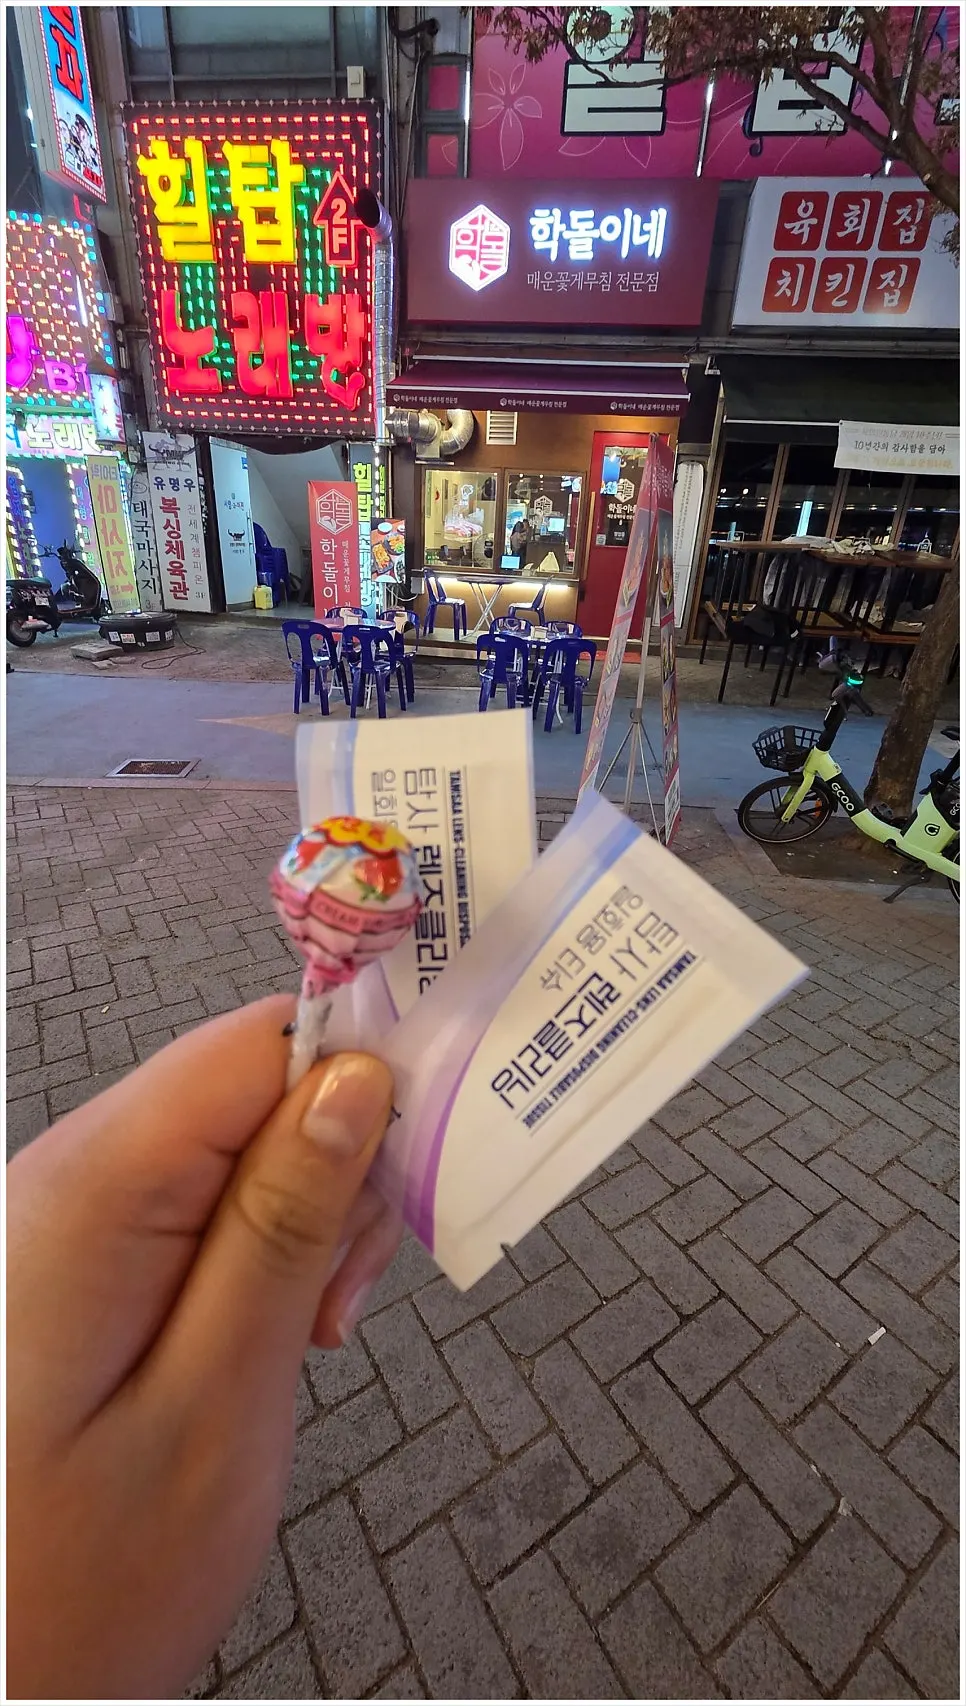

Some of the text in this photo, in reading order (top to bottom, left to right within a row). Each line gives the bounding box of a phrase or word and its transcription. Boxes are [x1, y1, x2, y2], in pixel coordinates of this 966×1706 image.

[137, 138, 305, 264] 힐탑
[784, 198, 926, 245] 육회집
[529, 207, 667, 262] 학돌이네
[527, 271, 660, 293] 매운꽃게무침 전문점
[774, 263, 909, 308] 치킨집
[161, 289, 366, 411] 노래방
[153, 476, 196, 493] 유명우
[132, 500, 157, 595] 태국마사지
[159, 496, 190, 601] 복싱체육관
[320, 538, 339, 618] 학돌이
[404, 768, 439, 834] 탐사
[831, 782, 855, 812] GCOO
[539, 885, 644, 993] 일회용 티슈
[656, 949, 698, 991] TAMSAA
[490, 911, 680, 1110] 탐사 렌즈클리닝
[596, 986, 661, 1054] LENS-CLEANING
[550, 1047, 601, 1101] DISPOSABLE
